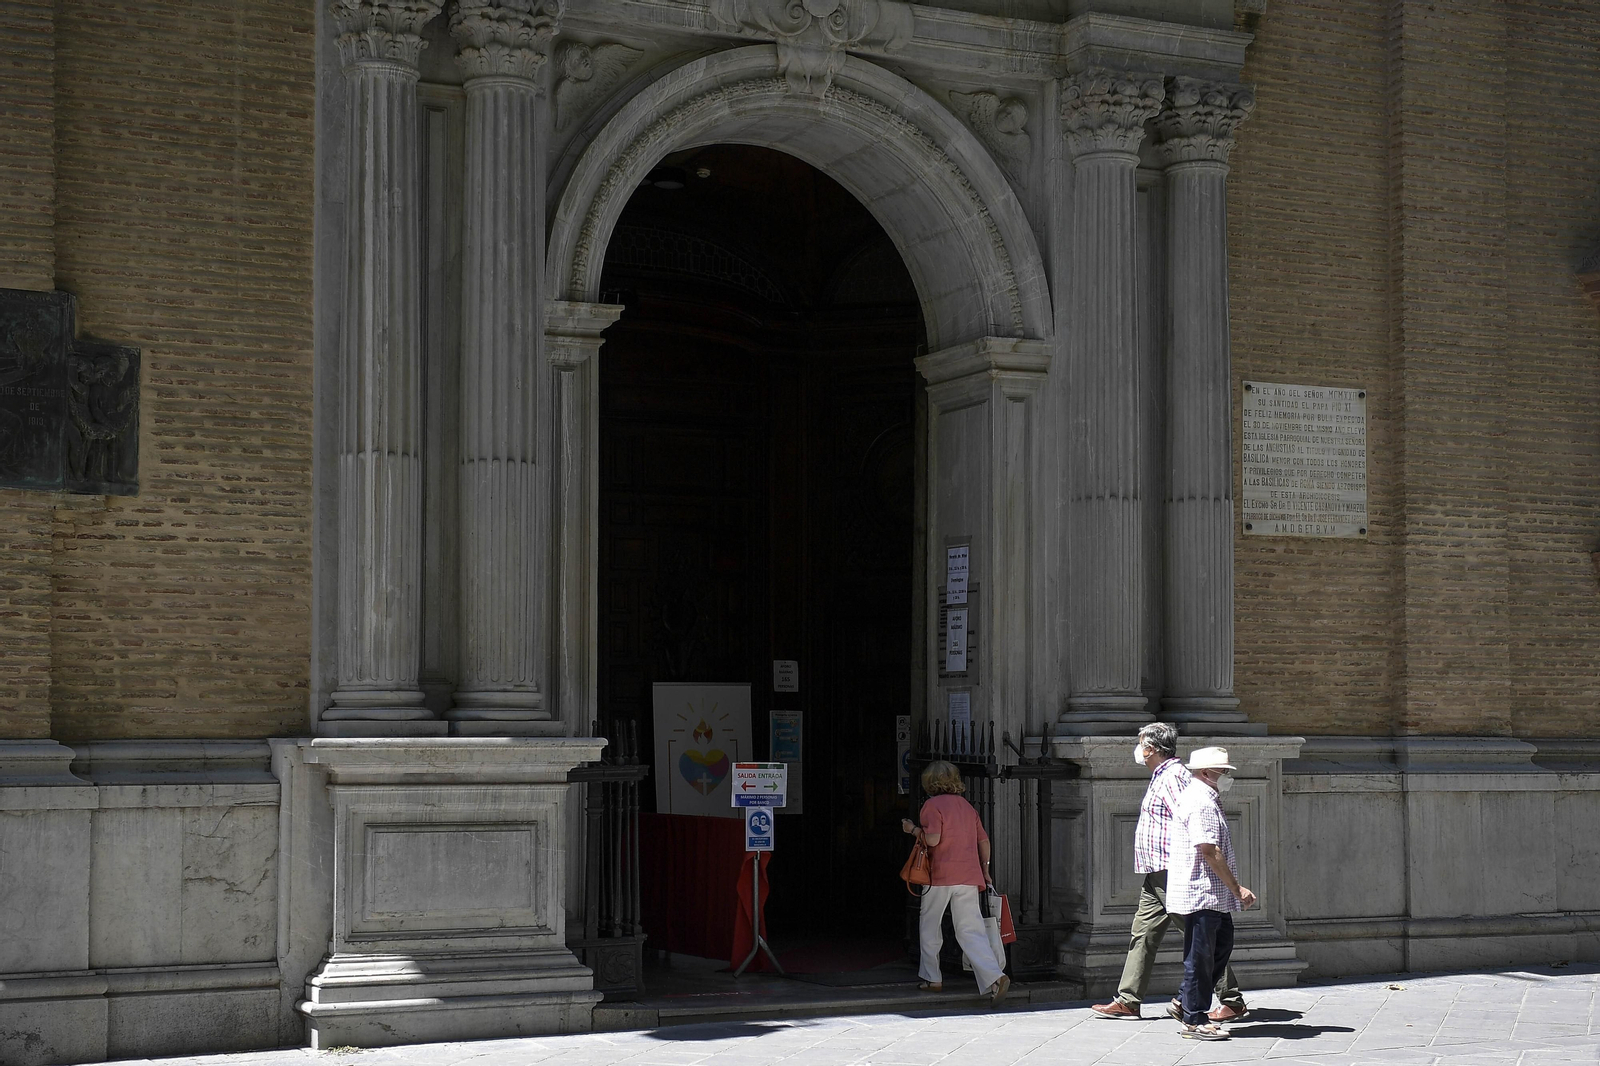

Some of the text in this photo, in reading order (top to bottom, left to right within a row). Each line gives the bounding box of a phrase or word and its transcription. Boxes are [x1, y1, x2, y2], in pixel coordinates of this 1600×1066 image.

[5, 386, 15, 396] DE
[16, 387, 65, 398] SEPTIEMBRE
[1251, 387, 1260, 395] EN
[1289, 389, 1301, 397] DEL
[1303, 390, 1324, 399] SEÑOR
[30, 402, 40, 411] DE
[1269, 400, 1299, 409] SANTIDAD
[1313, 403, 1328, 411] PAPA
[1244, 409, 1252, 417] DE
[1255, 410, 1272, 418] FELIZ
[1274, 411, 1300, 420] MEMORIA
[1303, 413, 1315, 421] POR
[1272, 422, 1302, 431] NOVIEMBRE
[1304, 424, 1315, 432] DEL
[1244, 432, 1365, 446] ESTA IGLESIA PARROQUIAL DE NUESTRA SEÑORA
[1244, 443, 1252, 451] DE
[1253, 444, 1264, 452] LAS
[1266, 443, 1296, 453] ANGUSTIAS
[1332, 448, 1357, 457] DIGNIDAD
[1359, 449, 1365, 457] DE
[1244, 453, 1365, 469] BASILICA MENOR CON TODOS LOS HONORES
[1244, 467, 1365, 480] Y PRIVILEGIOS QUE POR DERECHO COMPETEN
[1249, 478, 1261, 486] LAS
[1261, 477, 1290, 487] BASILICAS
[1292, 480, 1299, 488] DE
[1316, 481, 1336, 490] SIENDO
[1337, 482, 1366, 491] ARZOBISPO
[1270, 491, 1279, 499] DE
[1281, 491, 1296, 499] ESTA
[1243, 499, 1251, 509] EL
